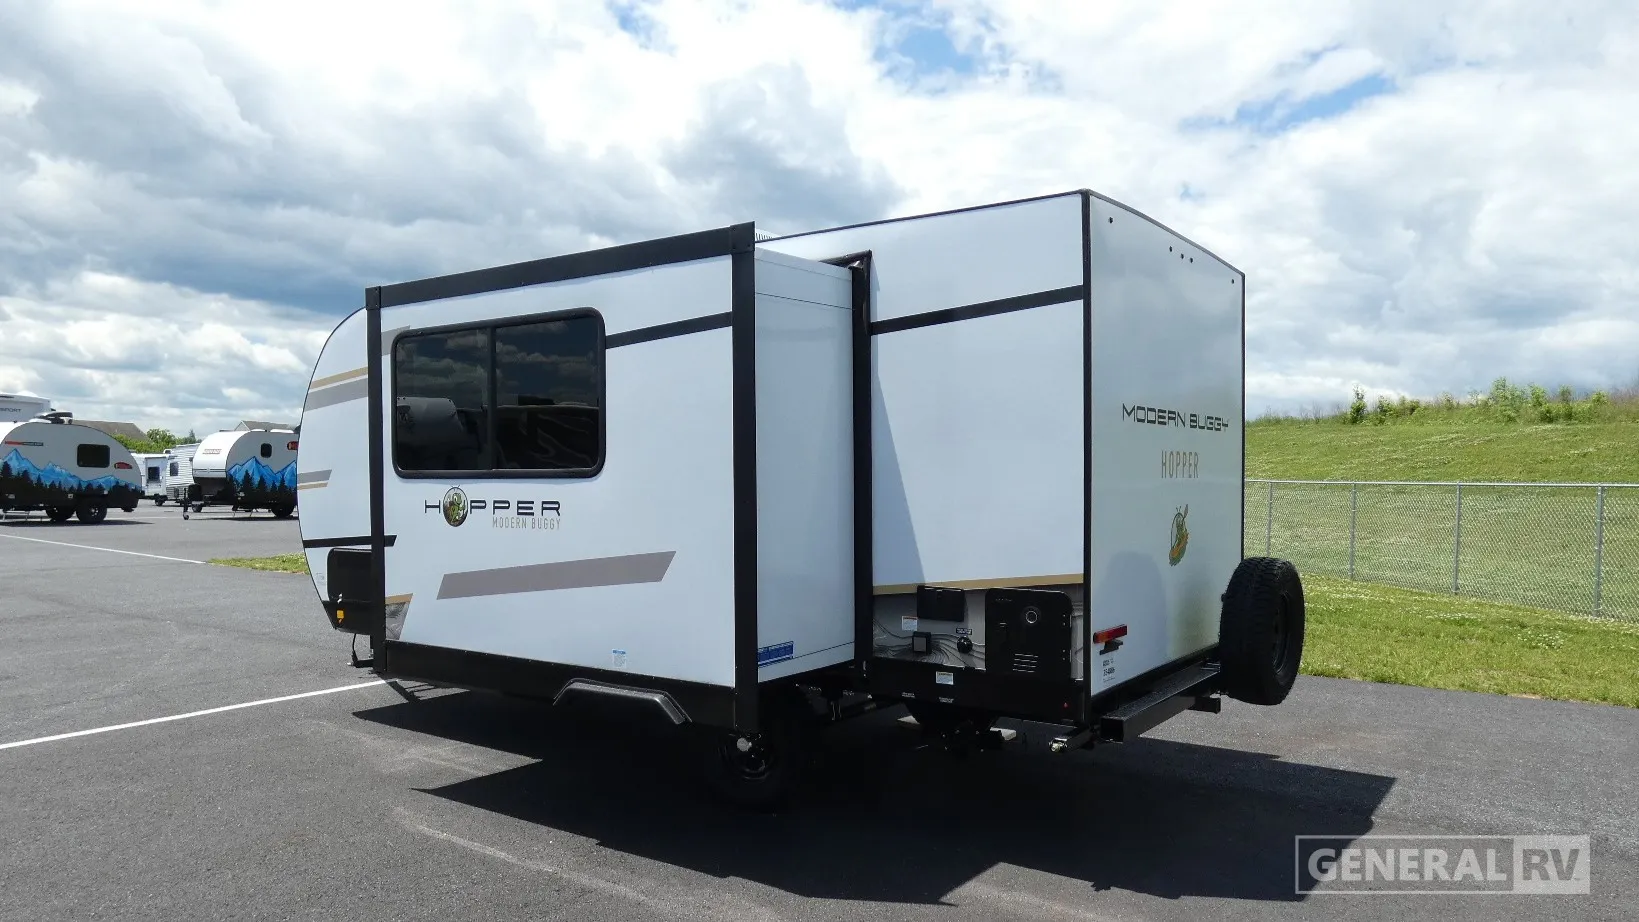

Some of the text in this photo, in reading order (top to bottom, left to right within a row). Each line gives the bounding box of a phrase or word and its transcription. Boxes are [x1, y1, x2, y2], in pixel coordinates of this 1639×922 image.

[1122, 403, 1229, 431] MODERN BUGGY
[1161, 450, 1199, 479] HOPPER
[492, 516, 561, 530] MODERN BUGGY
